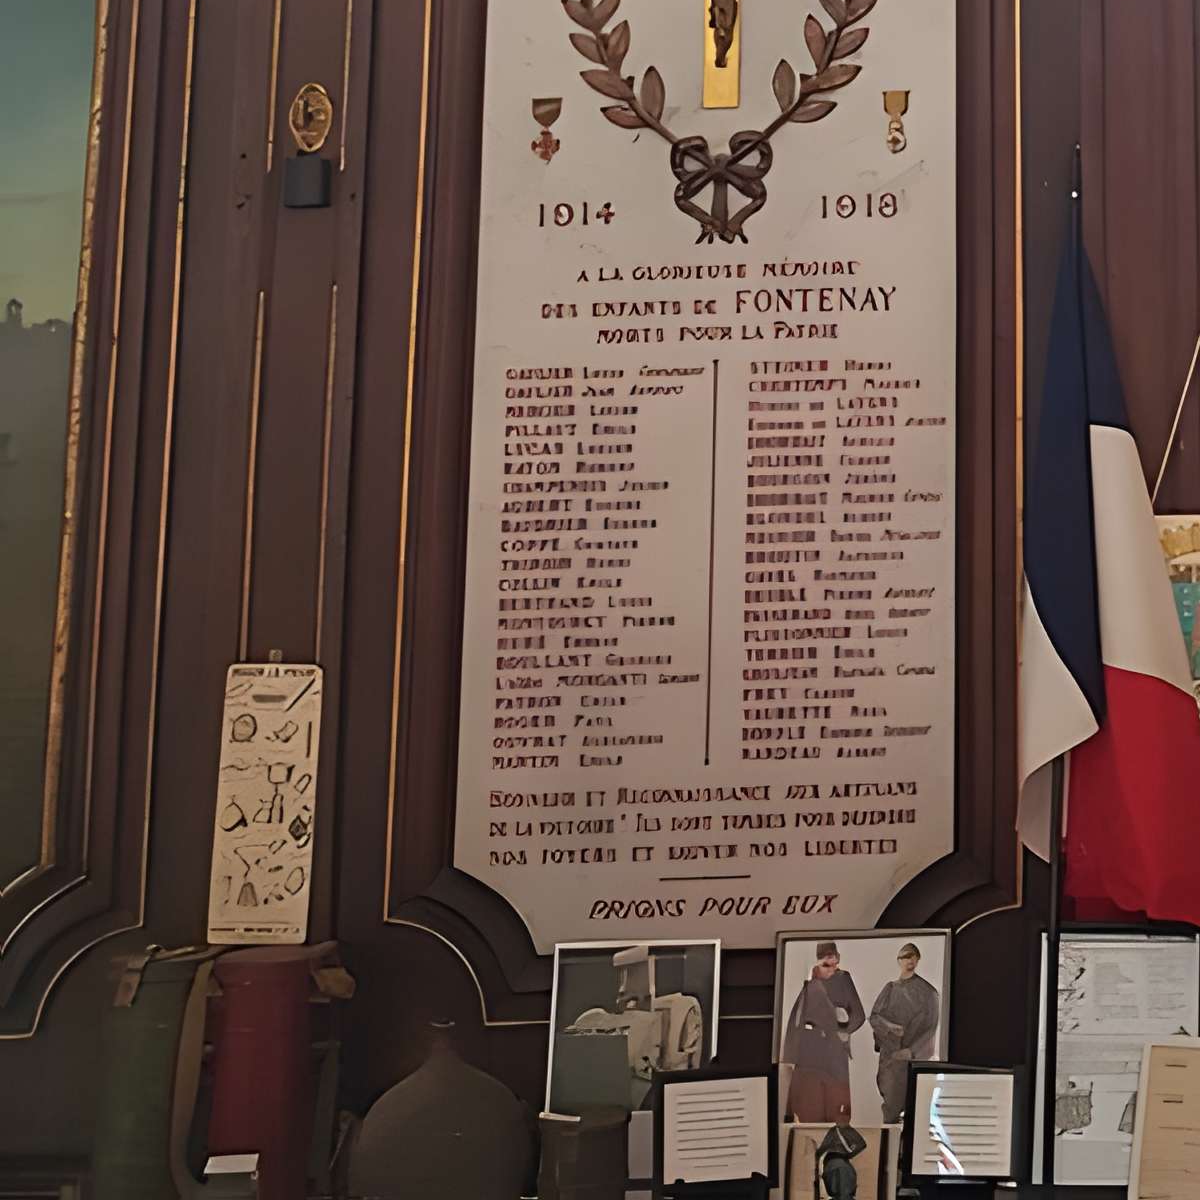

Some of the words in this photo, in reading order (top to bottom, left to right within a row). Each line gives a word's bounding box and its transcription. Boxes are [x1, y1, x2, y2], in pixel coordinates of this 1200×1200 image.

[539, 201, 615, 227] 1914
[821, 192, 898, 219] 1918
[736, 286, 896, 314] FONTENAY
[741, 325, 764, 340] LA
[589, 899, 686, 920] PRIONS
[698, 896, 771, 917] POUR
[782, 894, 838, 915] EUX
